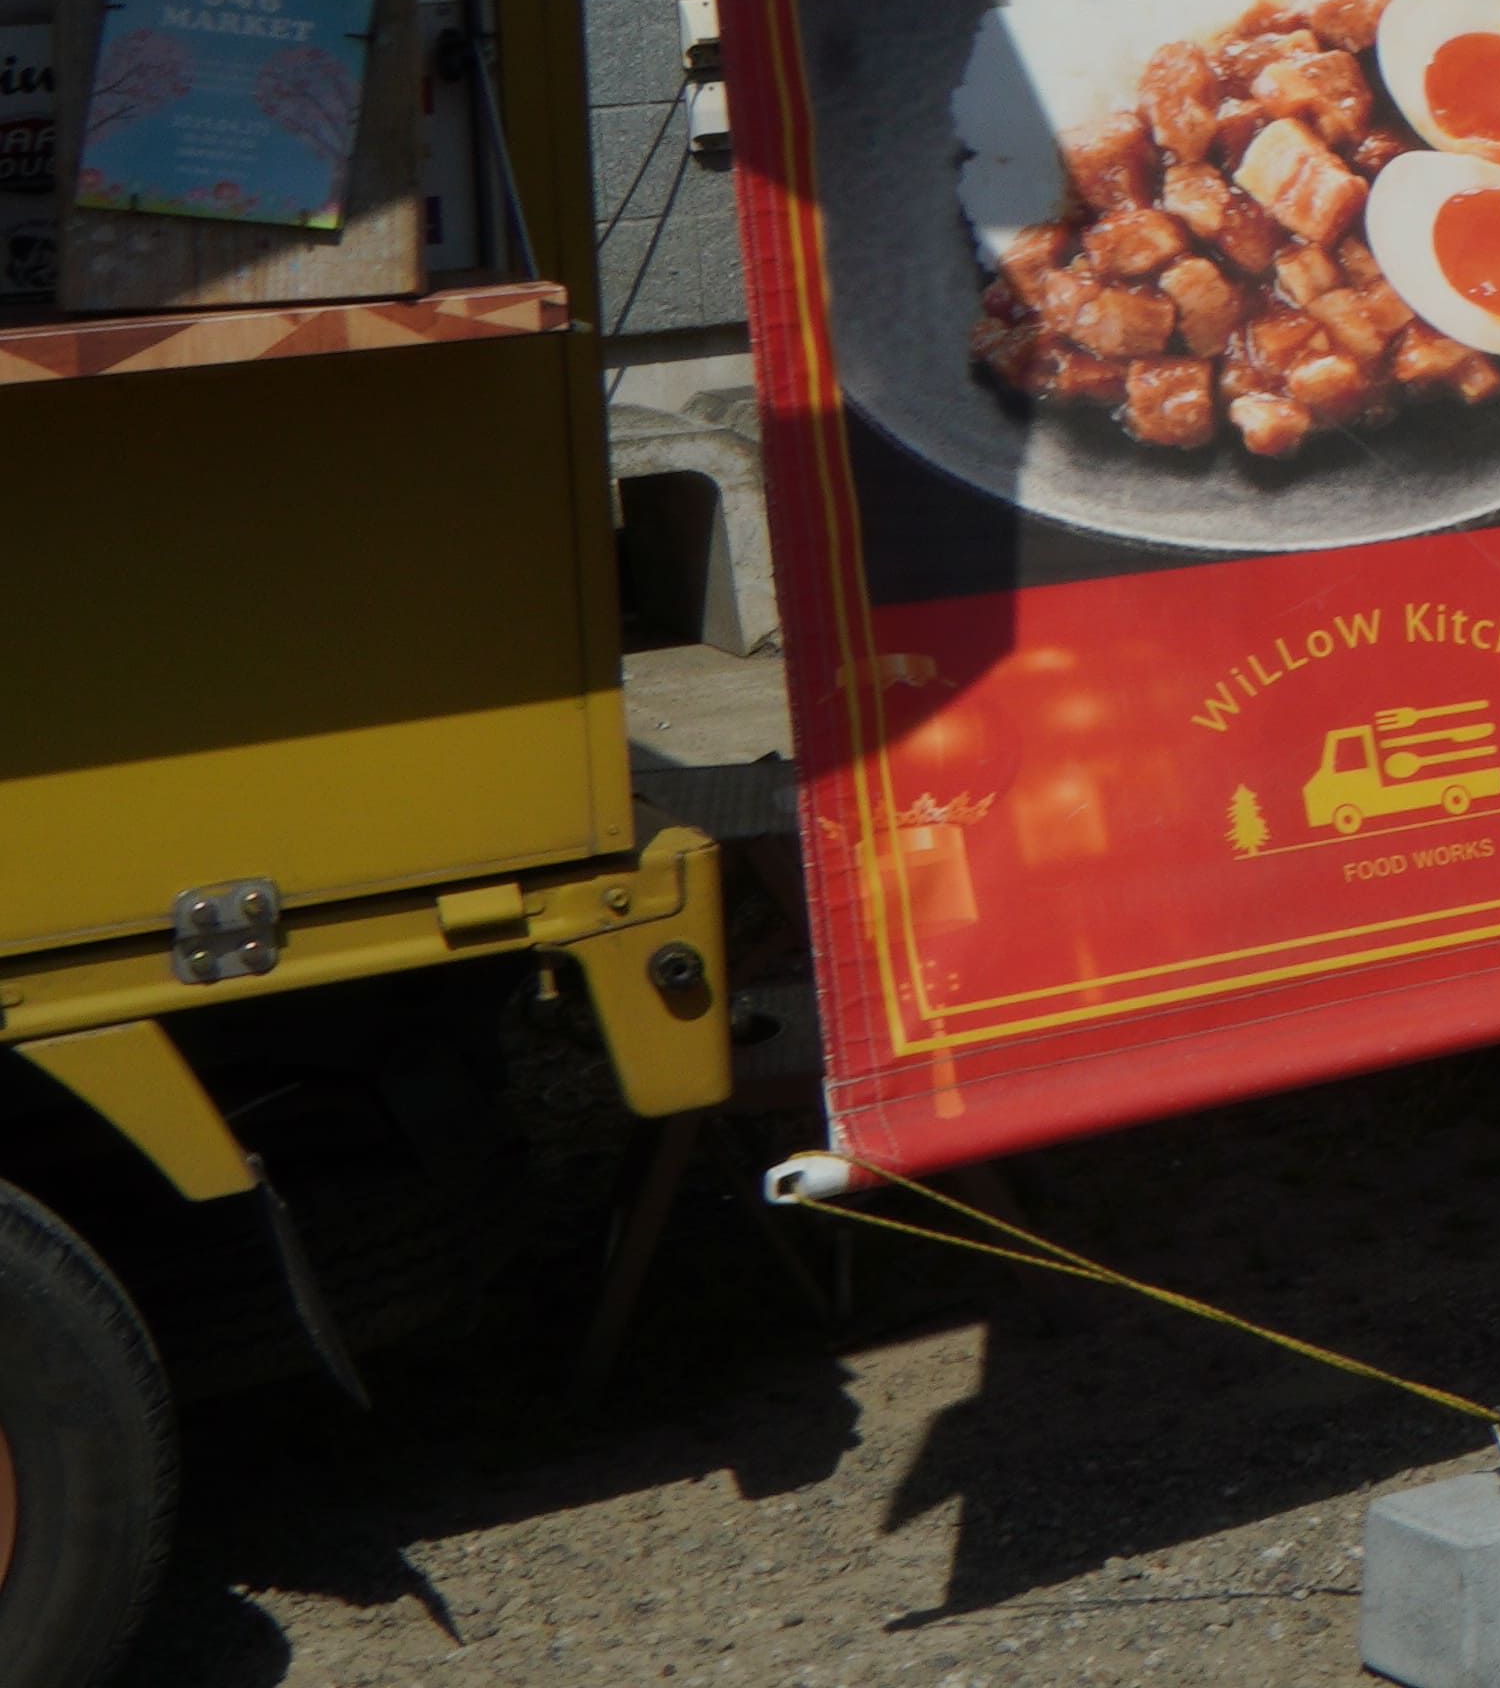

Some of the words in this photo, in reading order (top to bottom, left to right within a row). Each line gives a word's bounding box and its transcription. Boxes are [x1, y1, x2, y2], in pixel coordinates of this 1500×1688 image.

[1190, 608, 1382, 733] WiLLoW
[1342, 855, 1408, 883] FOOD
[1412, 838, 1496, 870] WORKS
